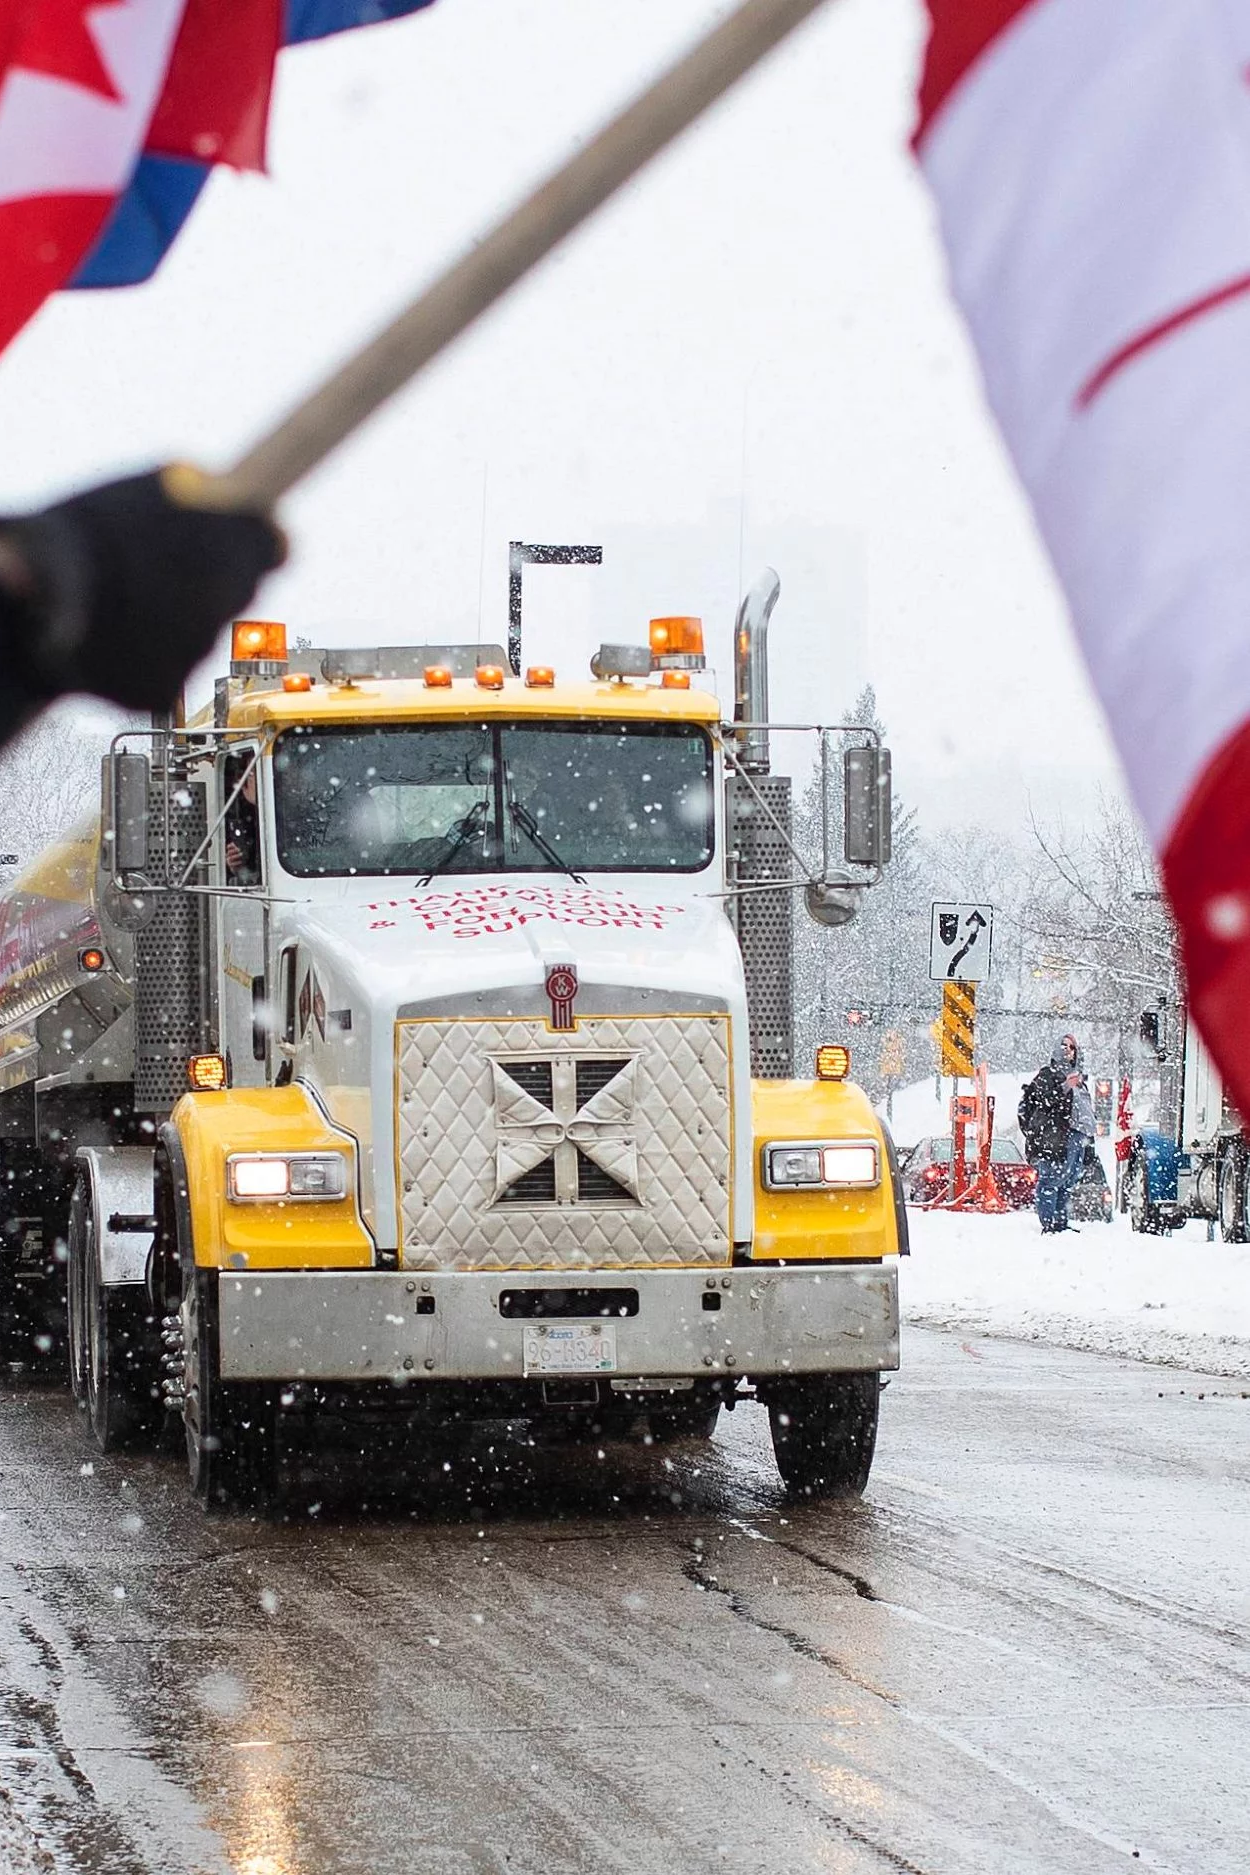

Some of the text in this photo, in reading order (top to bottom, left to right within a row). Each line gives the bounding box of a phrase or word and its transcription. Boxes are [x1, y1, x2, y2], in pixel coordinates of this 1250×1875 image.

[358, 885, 623, 910] THANK YOU
[414, 890, 603, 911] CANADA
[370, 895, 685, 930] & THE WORLD
[426, 902, 661, 930] FOR YOUR
[453, 911, 669, 938] SUPPORT
